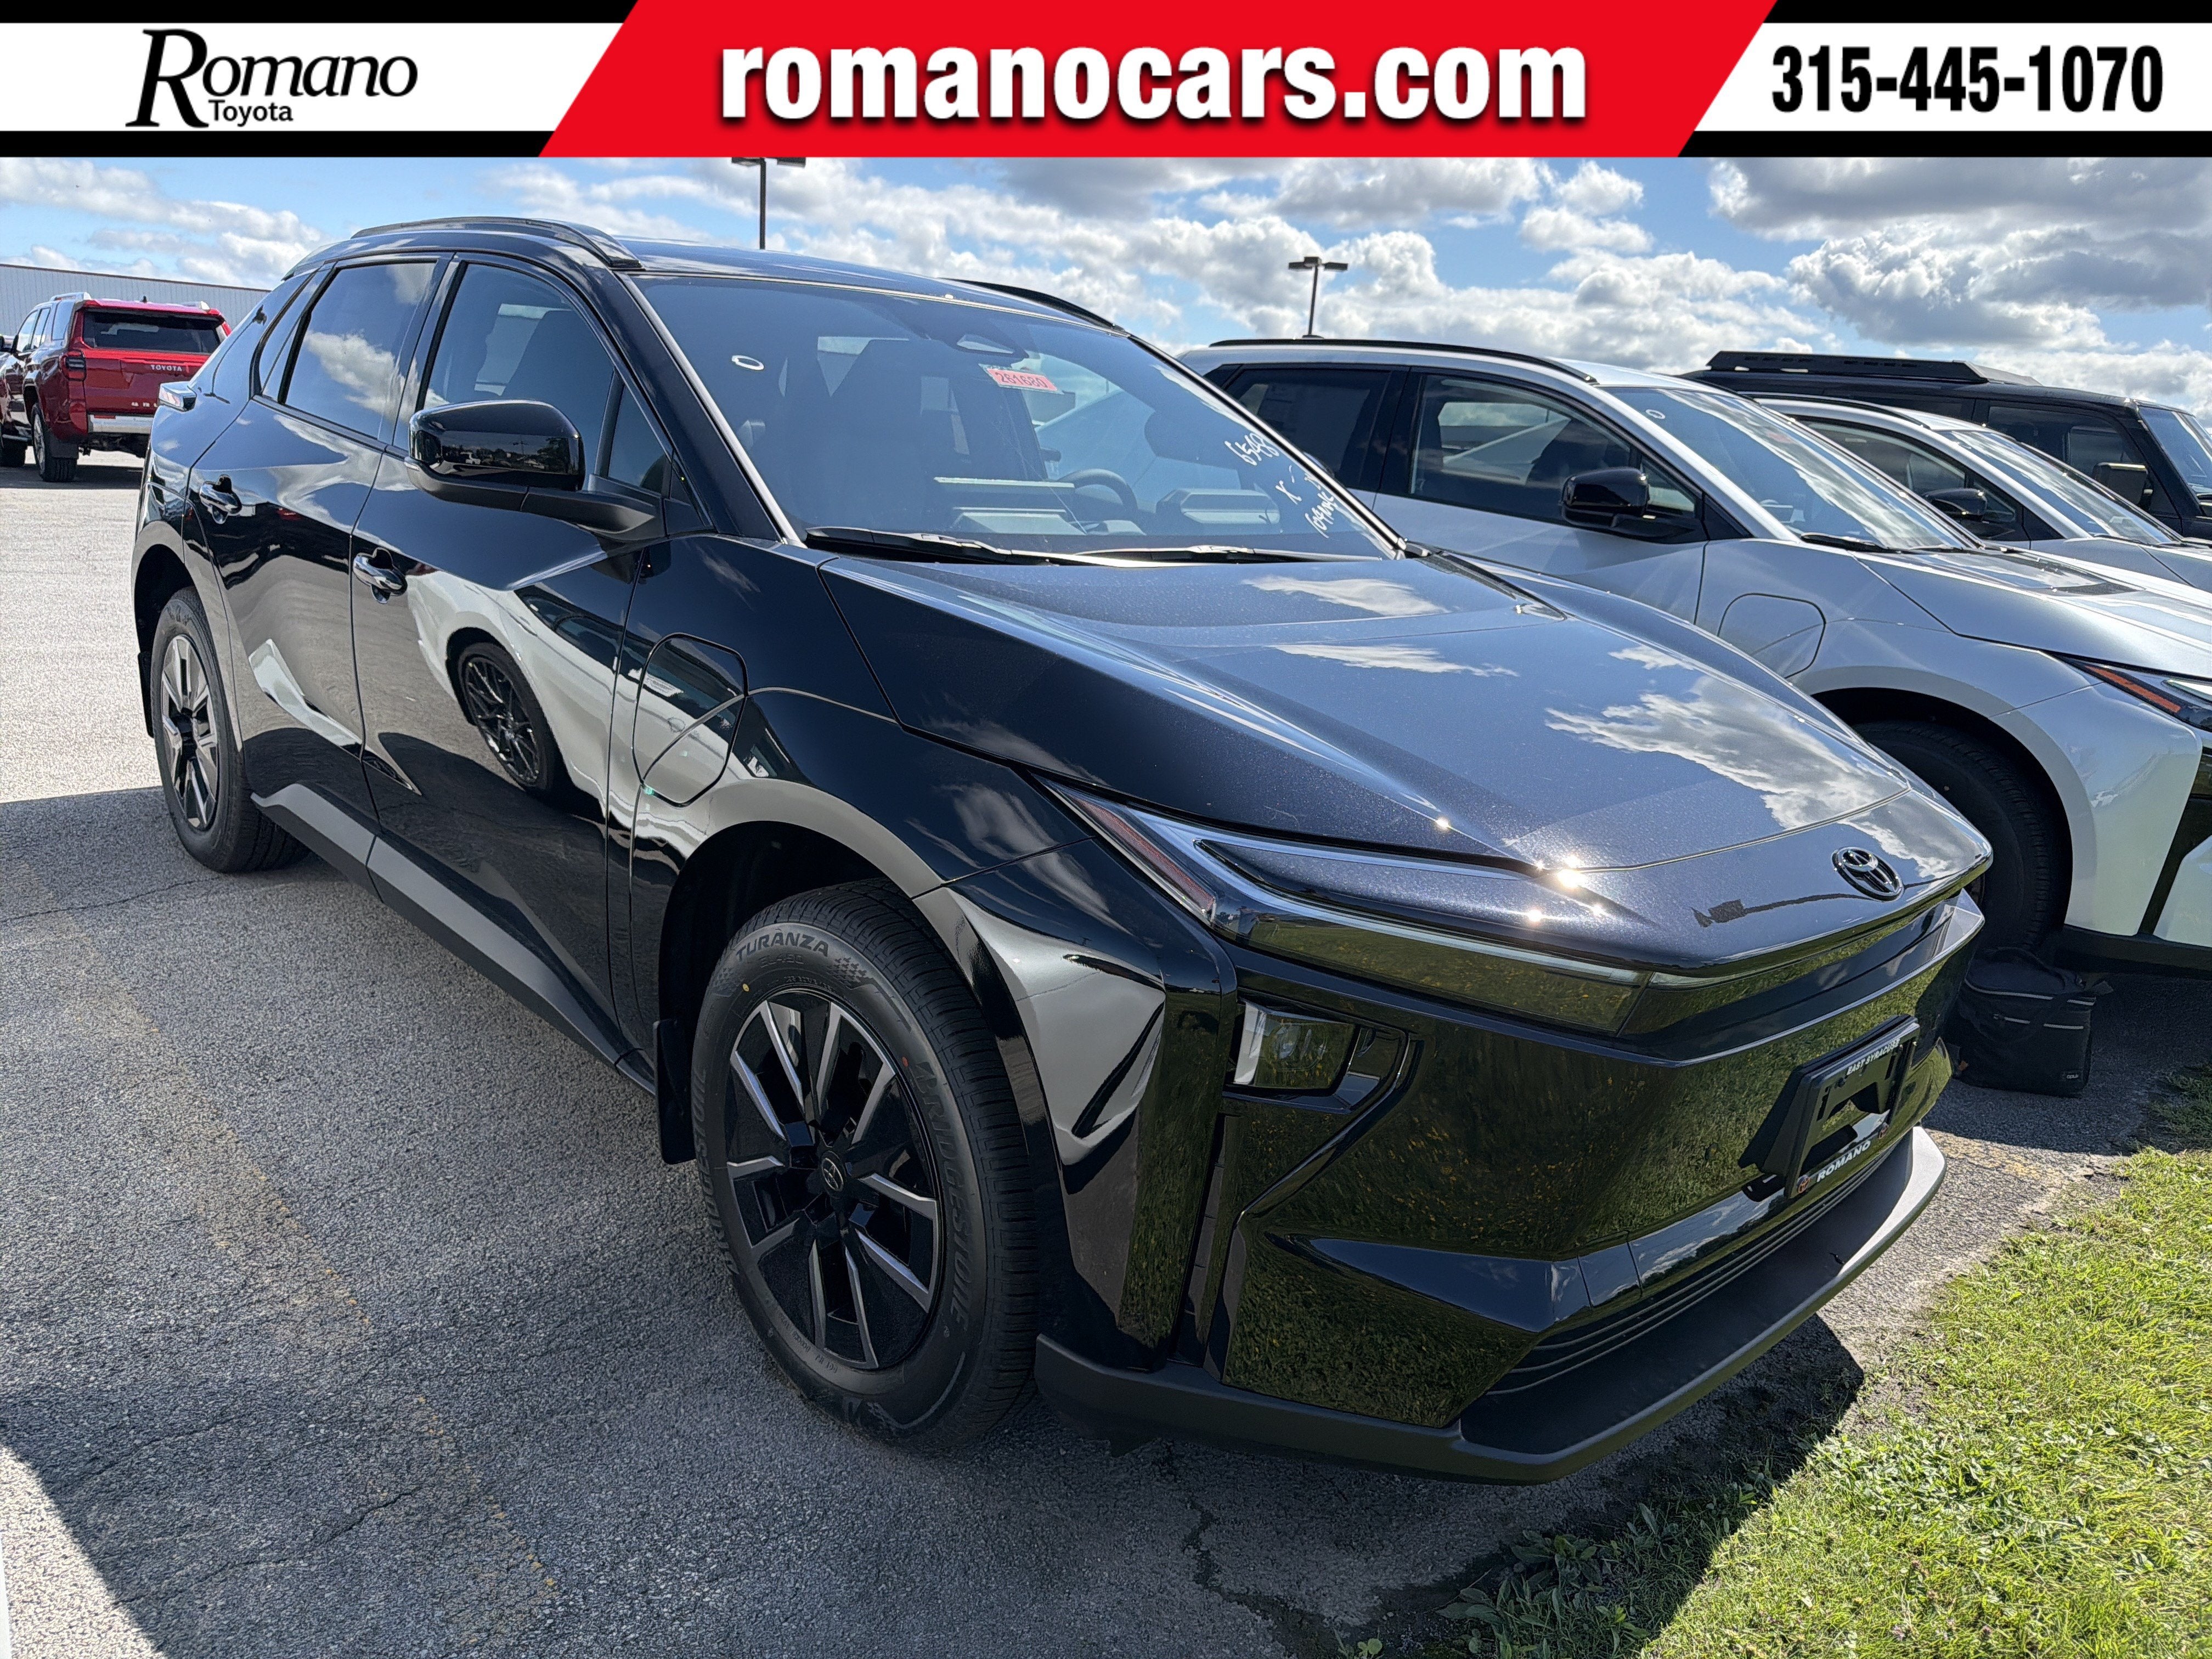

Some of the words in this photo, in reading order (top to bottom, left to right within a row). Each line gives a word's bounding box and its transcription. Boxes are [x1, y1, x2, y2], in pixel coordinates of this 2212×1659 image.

[736, 932, 829, 961] TURANZA
[1847, 1058, 1865, 1076] EAST
[1865, 1038, 1900, 1065] SYRACUSE
[1816, 1140, 1871, 1183] ROMANO
[913, 1062, 973, 1331] BRIDGESTONE
